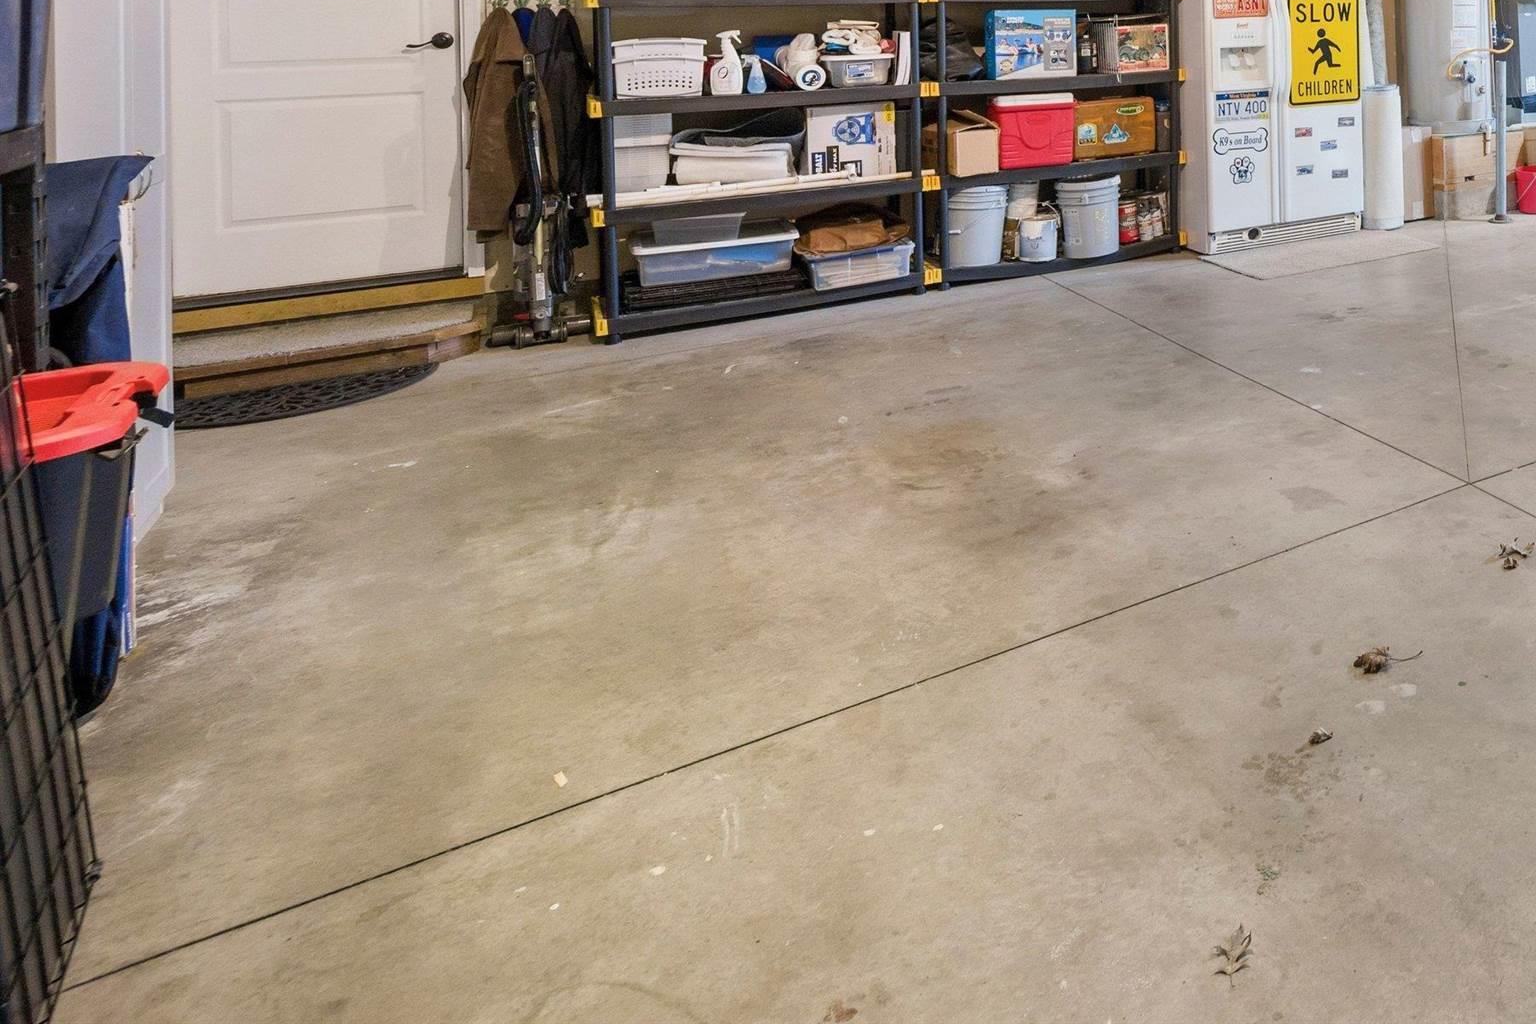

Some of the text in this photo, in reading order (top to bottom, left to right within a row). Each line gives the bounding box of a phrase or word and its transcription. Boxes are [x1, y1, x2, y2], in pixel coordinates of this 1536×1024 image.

[1296, 2, 1351, 23] SLOW
[1298, 79, 1352, 97] CHILDREN
[1218, 100, 1267, 116] NTV 400
[1243, 135, 1263, 145] Board
